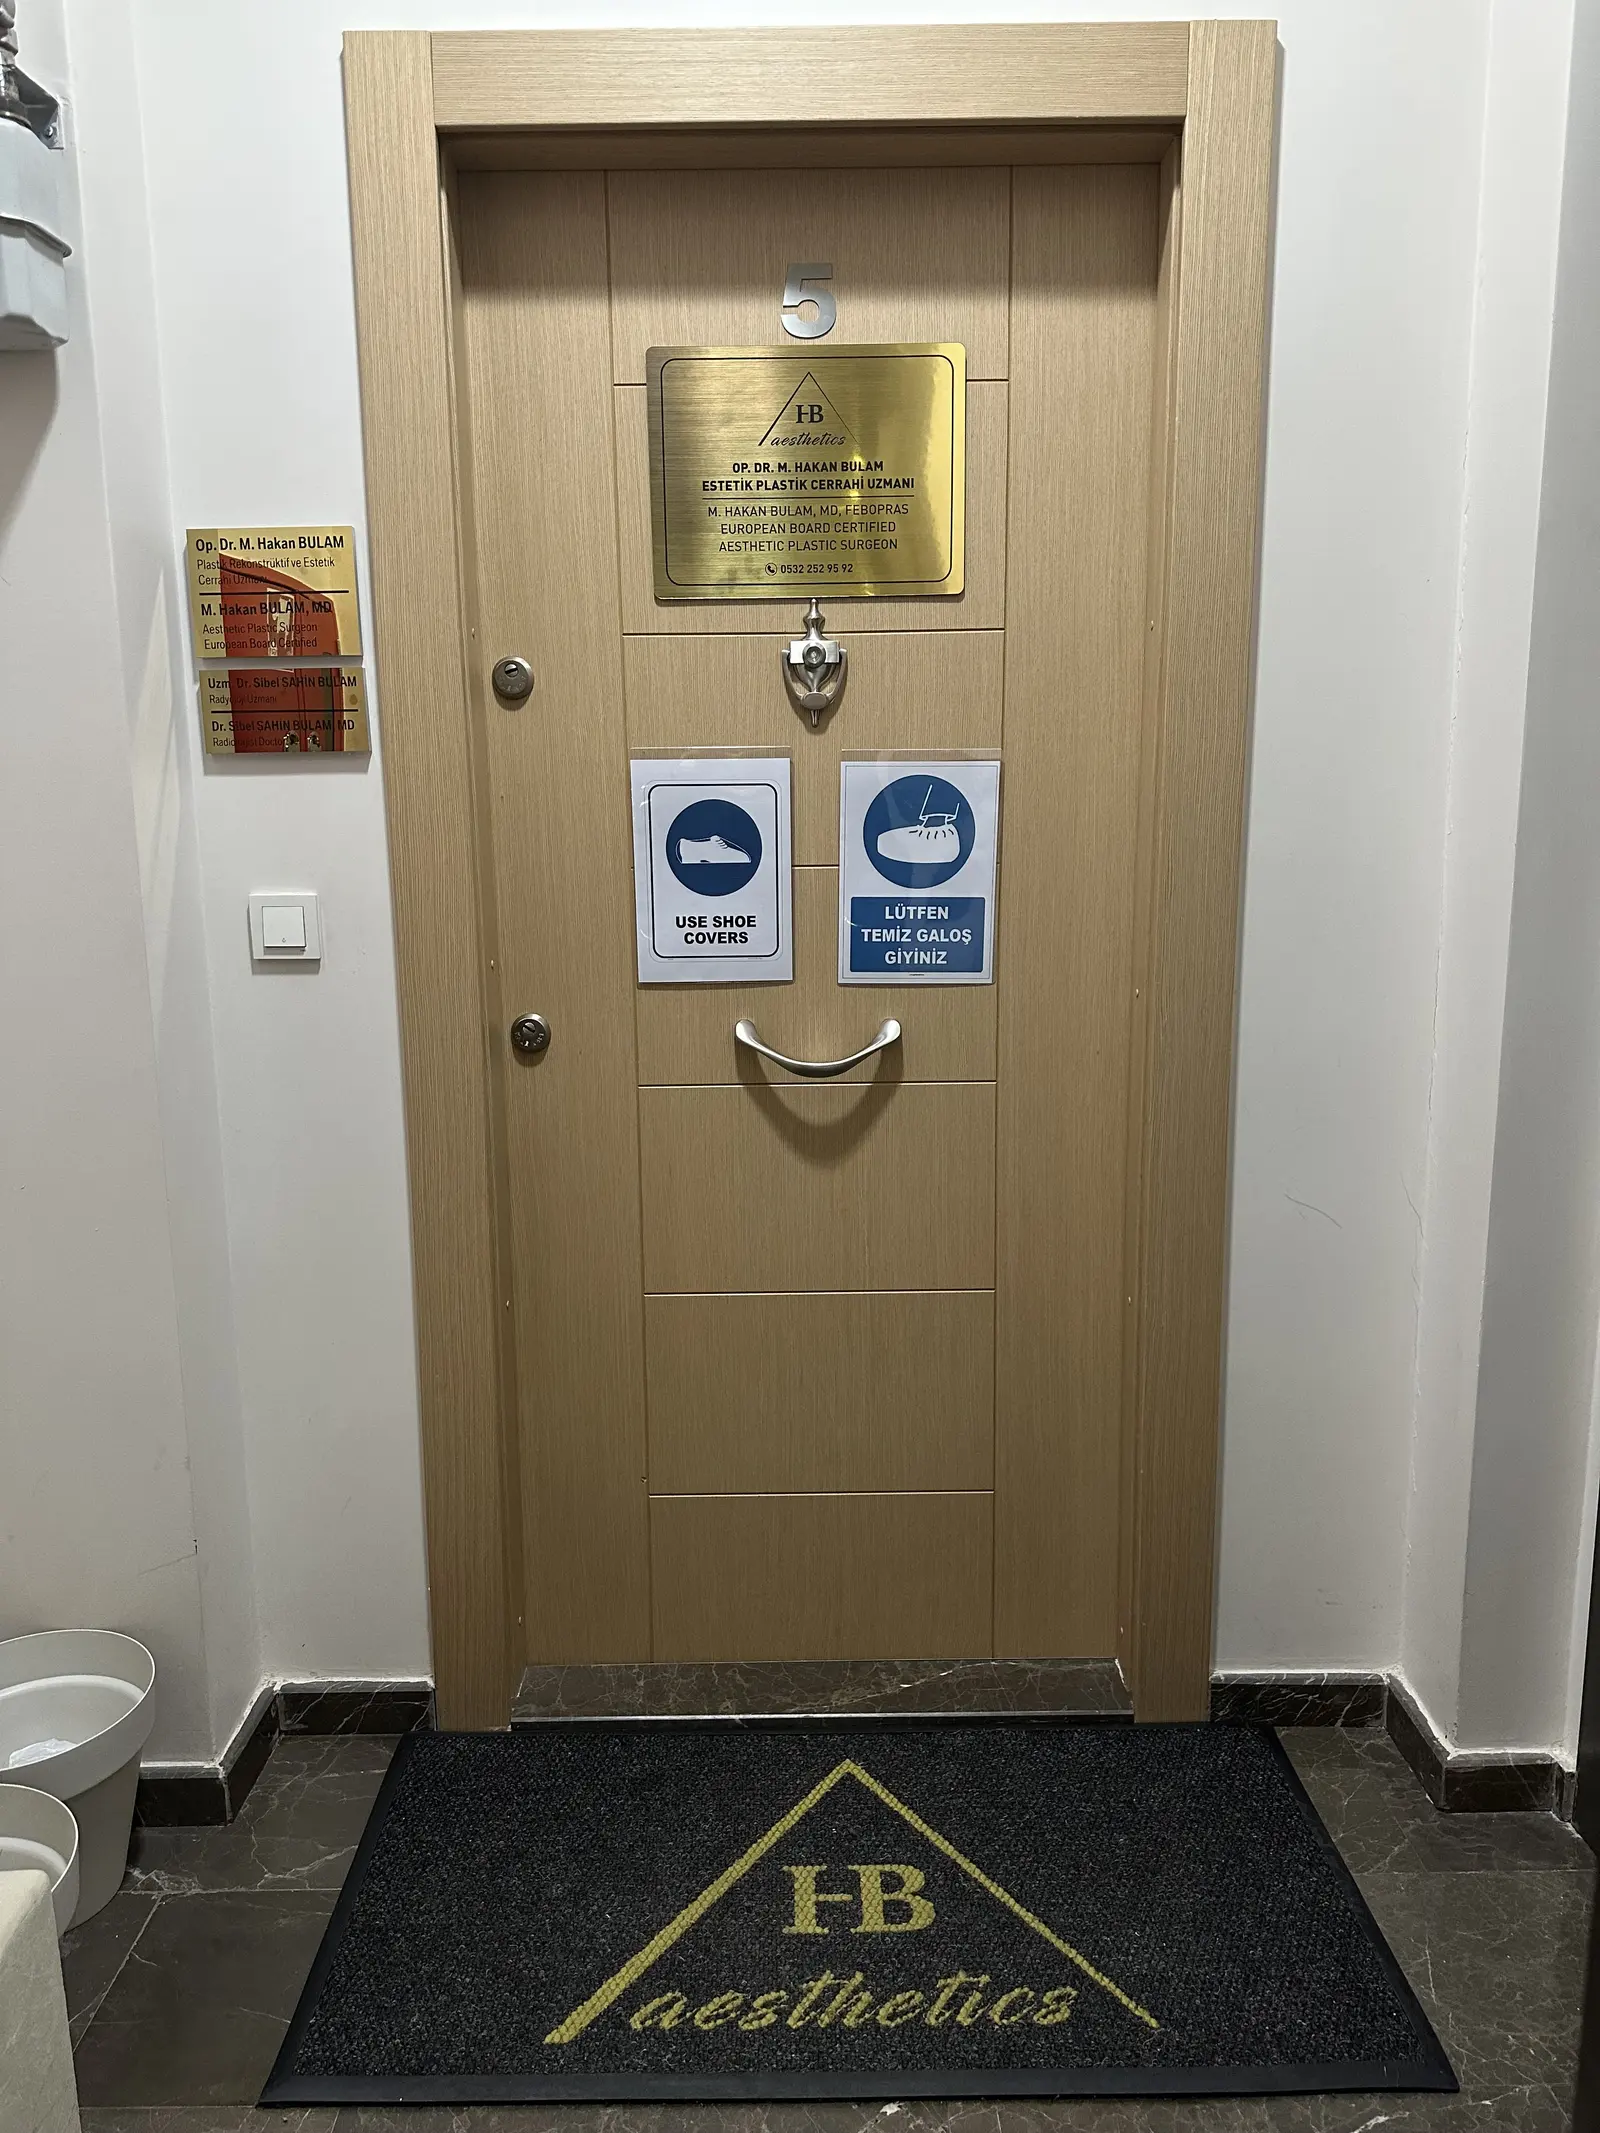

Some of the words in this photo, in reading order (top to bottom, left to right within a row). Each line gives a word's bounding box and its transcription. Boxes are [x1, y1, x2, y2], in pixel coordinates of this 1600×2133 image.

[780, 263, 836, 338] 5
[796, 404, 824, 423] HB
[770, 432, 846, 447] aesthetics
[732, 462, 750, 474] OP.
[754, 462, 774, 473] DR.
[778, 462, 792, 473] M.
[795, 462, 837, 472] HAKAN
[841, 461, 884, 472] BULAM
[702, 478, 753, 492] ESTETİK
[756, 476, 807, 491] PLASTİK
[810, 476, 864, 490] CERRAHİ
[868, 478, 914, 489] UZMANI
[708, 506, 721, 517] M.
[725, 506, 767, 517] HAKAN
[770, 505, 816, 518] BULAM,
[820, 504, 842, 518] MD,
[846, 504, 909, 515] FEBOPRAS
[721, 523, 786, 534] EUROPEAN
[790, 522, 830, 534] BOARD
[834, 521, 896, 533] CERTIFIED
[196, 539, 216, 553] Op.
[220, 538, 236, 550] Dr.
[240, 538, 254, 550] M.
[258, 537, 296, 550] Hakan
[298, 536, 344, 549] BULAM
[719, 540, 784, 552] AESTHETIC
[788, 540, 836, 551] PLASTIC
[840, 539, 898, 550] SURGEON
[197, 559, 227, 570] Plastik
[291, 560, 301, 568] ve
[304, 557, 335, 568] Estetik
[780, 564, 804, 574] 0532
[806, 564, 825, 574] 252
[827, 563, 839, 573] 95
[841, 563, 853, 573] 92
[201, 604, 216, 616] M.
[220, 603, 257, 615] Hakan
[260, 601, 309, 616] BULAM,
[203, 623, 246, 634] Aesthetic
[248, 622, 277, 633] Plastic
[280, 622, 318, 634] Surgeon
[204, 639, 248, 651] European
[250, 638, 276, 649] Board
[237, 678, 250, 688] Dr.
[254, 677, 280, 688] Sibel
[318, 676, 357, 688] BULAM
[210, 695, 245, 705] Radyooji
[212, 721, 226, 731] Dr.
[229, 720, 254, 731] Sibel
[338, 720, 355, 730] MD
[258, 737, 284, 746] Docto
[885, 904, 949, 920] LÜTFEN
[676, 916, 708, 928] USE
[712, 915, 756, 928] SHOE
[684, 931, 749, 944] COVERS
[861, 926, 912, 942] TEMİZ
[916, 928, 972, 945] GALOŞ
[884, 949, 947, 965] GİYİNİZ
[782, 1864, 936, 1935] HB
[629, 1970, 1080, 2032] aesthetics
